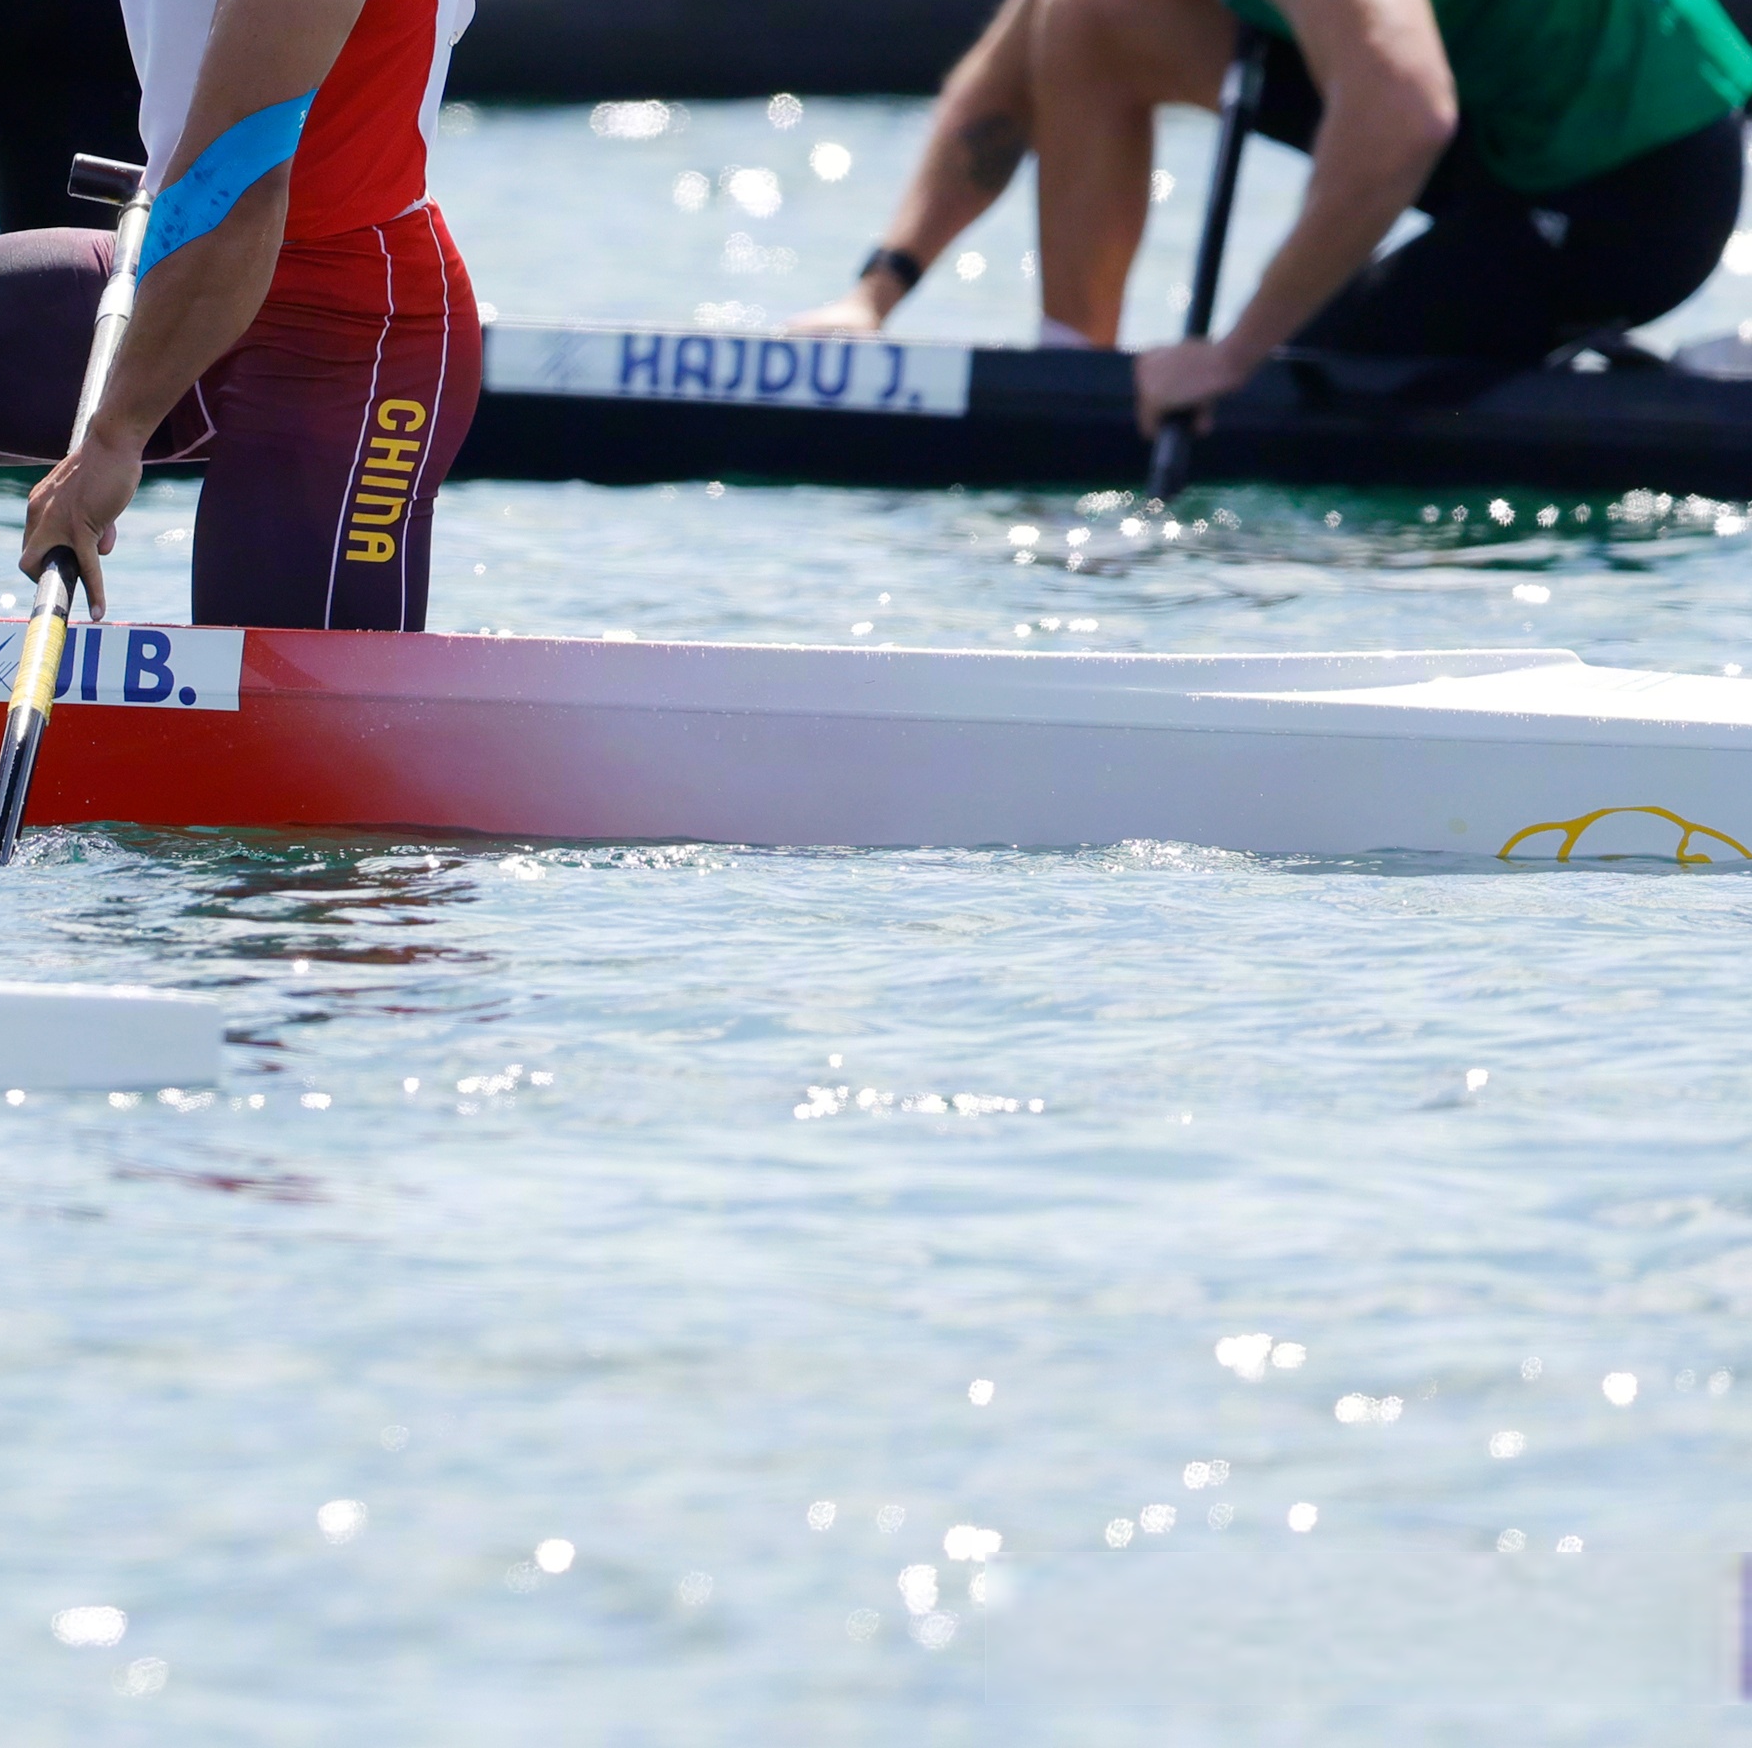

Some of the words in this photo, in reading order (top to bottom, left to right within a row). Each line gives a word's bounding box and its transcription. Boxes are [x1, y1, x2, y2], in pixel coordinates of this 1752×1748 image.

[616, 333, 854, 404] HAJDU
[876, 344, 923, 411] J.
[346, 399, 426, 563] CHINA
[124, 629, 197, 705] B.
